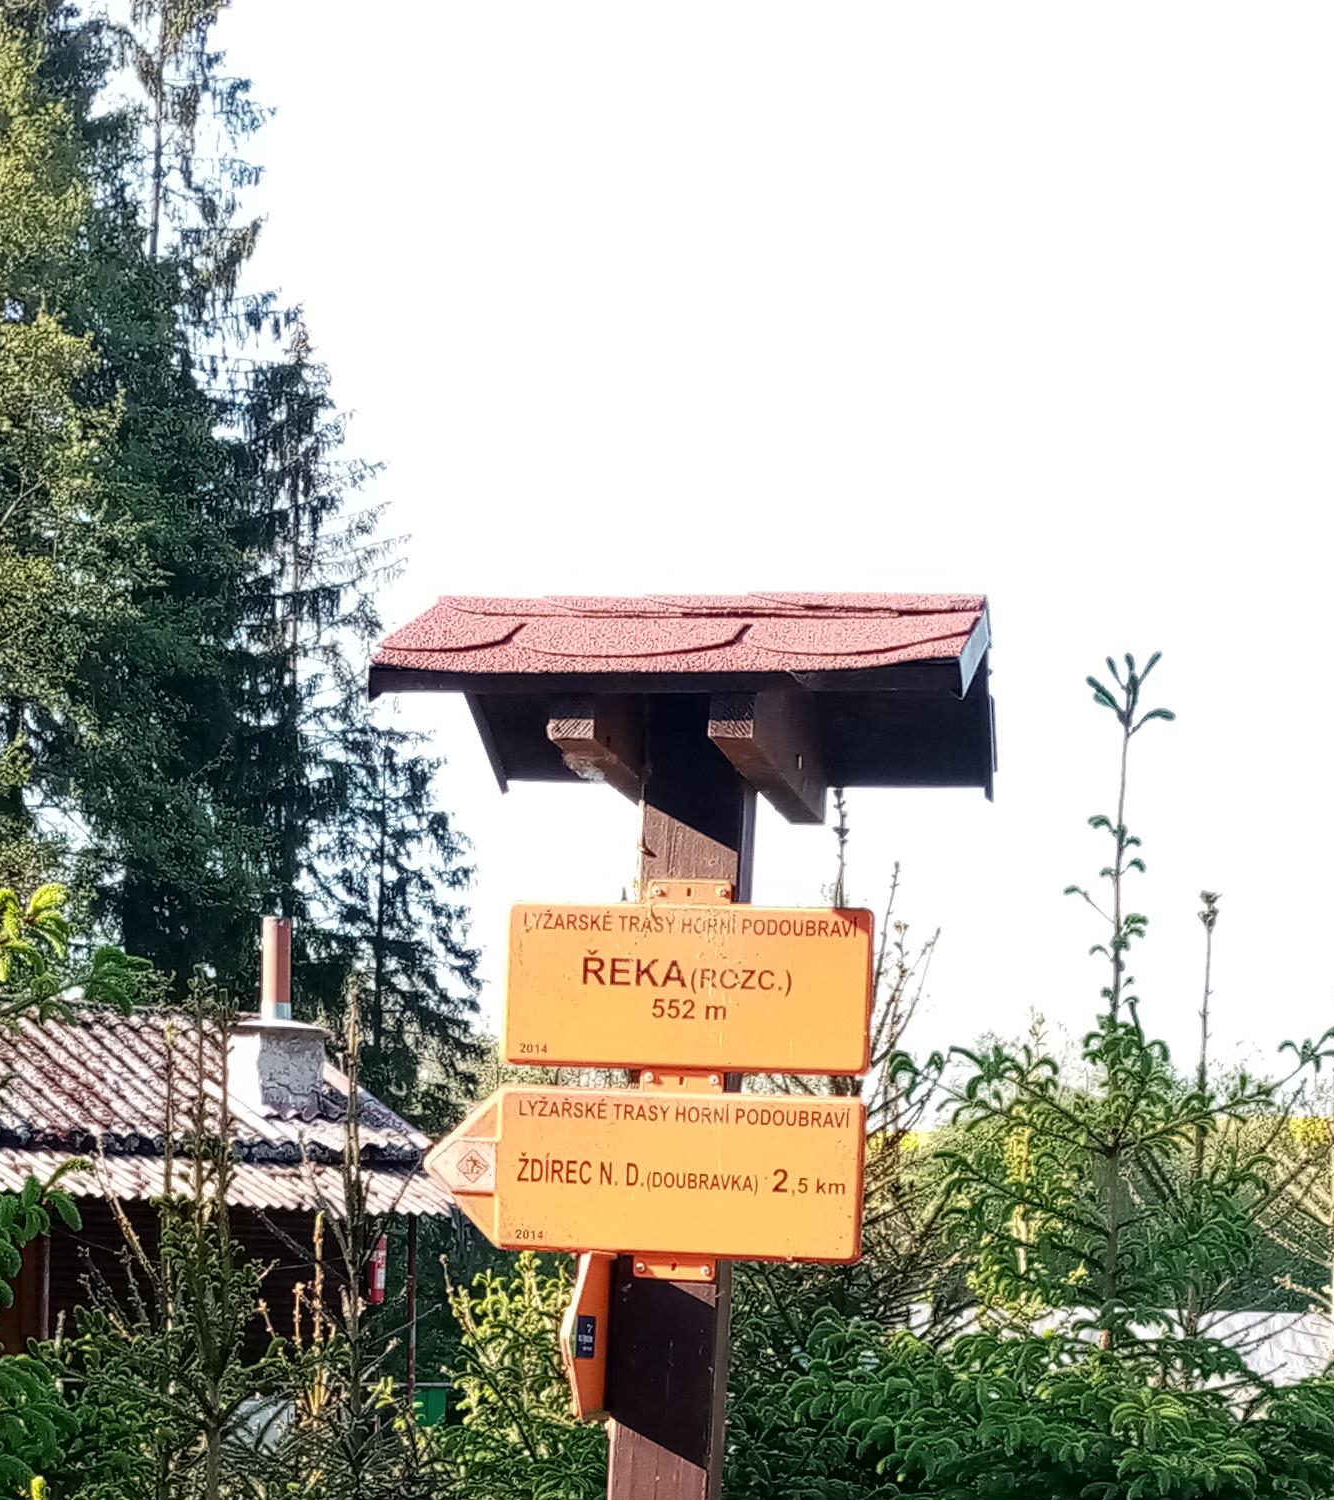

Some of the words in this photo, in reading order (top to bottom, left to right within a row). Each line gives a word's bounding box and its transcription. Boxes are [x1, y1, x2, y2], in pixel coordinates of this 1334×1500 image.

[618, 913, 676, 934] TRASY
[681, 913, 736, 935] HORNÍ
[741, 916, 858, 938] PODOUBRAVÍ
[651, 998, 696, 1020] 552
[704, 1003, 727, 1021] m
[519, 1042, 548, 1054] 2014
[612, 1102, 671, 1122] TRASY
[675, 1103, 730, 1125] HORNÍ
[734, 1107, 852, 1129] PODOUBRAVÍ
[516, 1151, 593, 1186] ŽDÍREC
[599, 1160, 619, 1187] N.
[771, 1168, 809, 1198] 2,5
[815, 1177, 847, 1196] km
[514, 1228, 544, 1241] 2014
